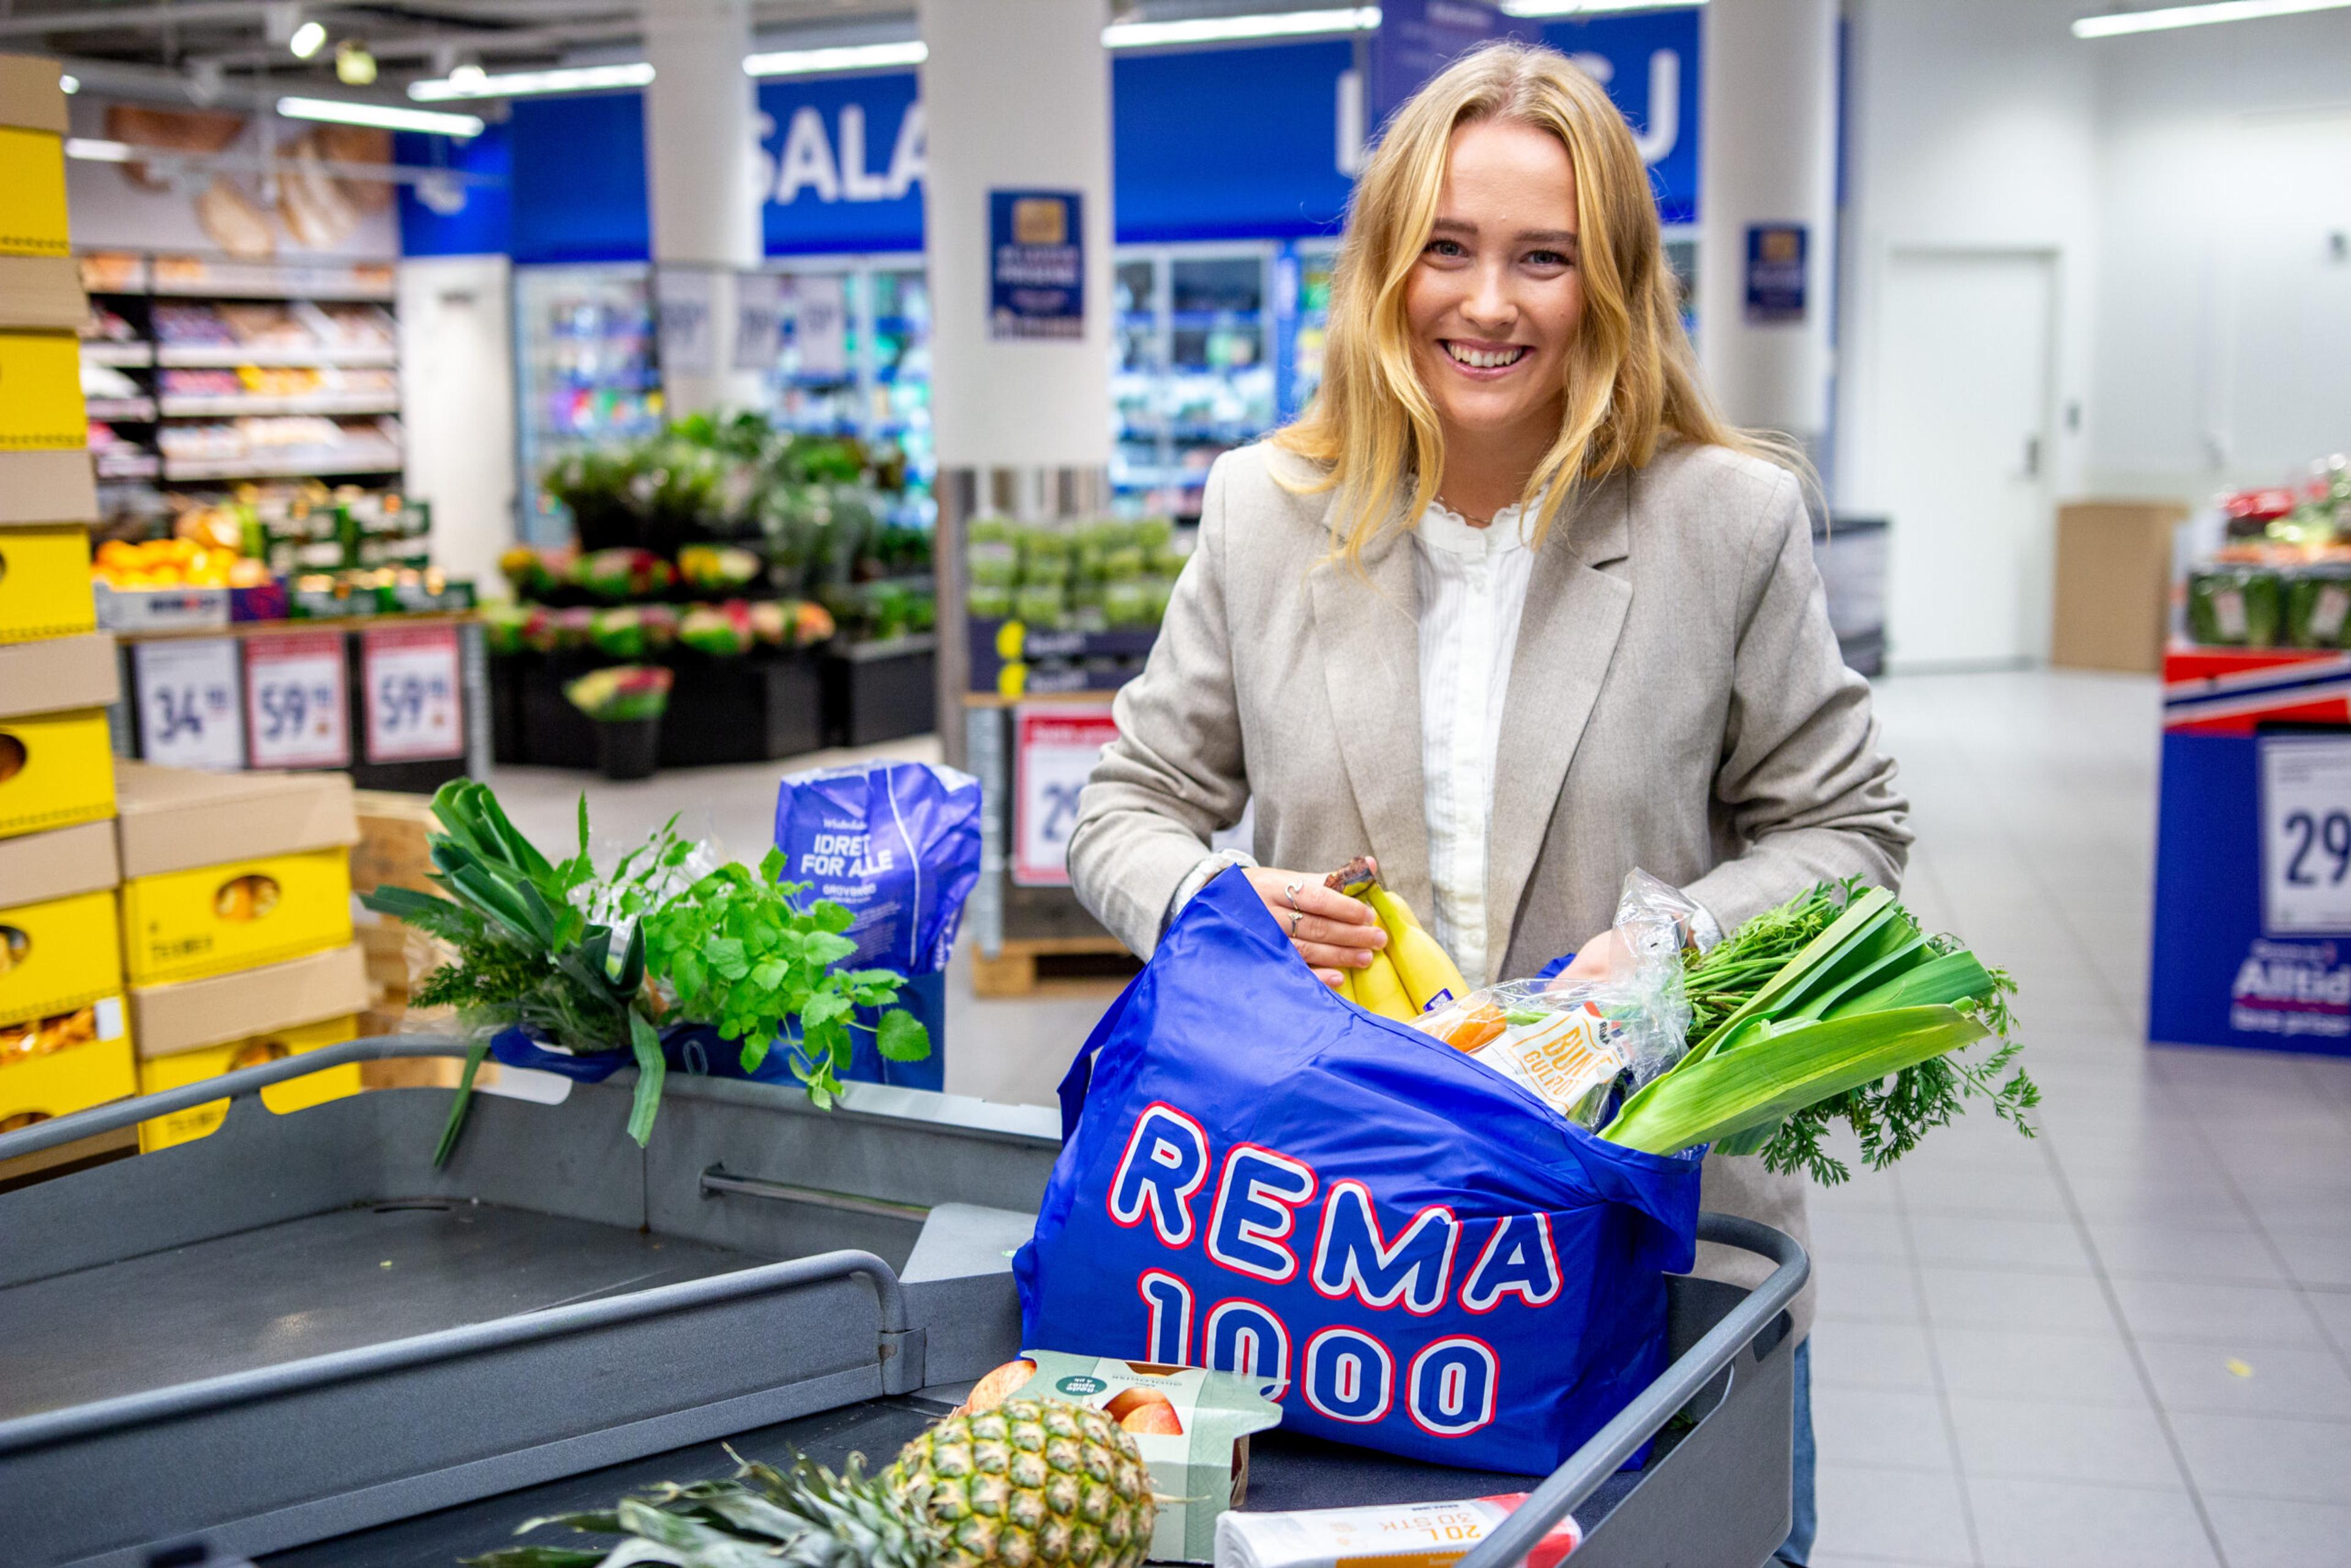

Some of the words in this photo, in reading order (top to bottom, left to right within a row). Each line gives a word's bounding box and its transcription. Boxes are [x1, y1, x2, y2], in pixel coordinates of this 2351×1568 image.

[156, 686, 203, 743] 34
[261, 682, 307, 740] 59
[381, 676, 424, 733] 59
[800, 853, 846, 877] FOR
[2284, 809, 2351, 886] 29
[1523, 1050, 1582, 1098] GULROT
[1542, 1026, 1613, 1078] BUNT
[1107, 1101, 1563, 1316] REMA
[1138, 1267, 1500, 1438] 1000
[1382, 1517, 1432, 1532] STK
[1420, 1529, 1439, 1541] L
[1440, 1512, 1471, 1525] 30
[1446, 1525, 1482, 1540] 20
